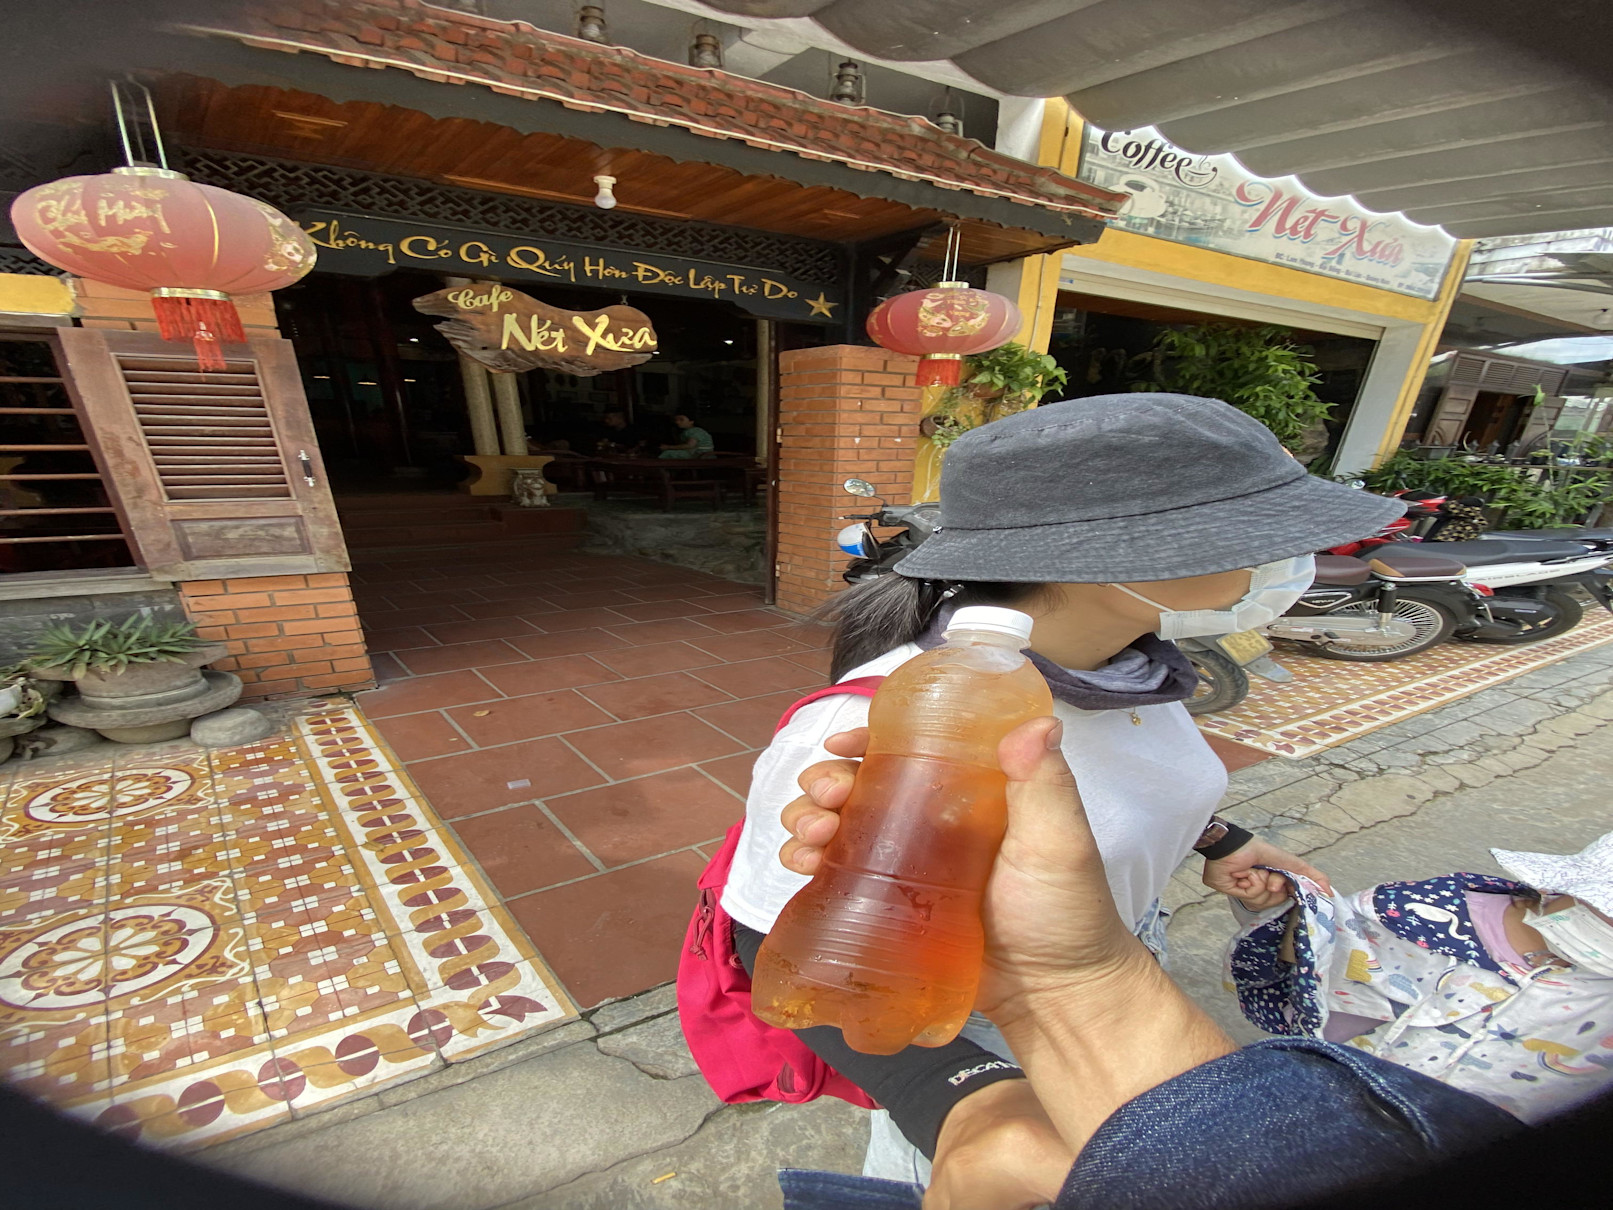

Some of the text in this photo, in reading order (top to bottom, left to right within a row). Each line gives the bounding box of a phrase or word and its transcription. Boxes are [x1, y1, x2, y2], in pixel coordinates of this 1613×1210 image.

[1101, 131, 1218, 187] Coffee
[294, 219, 397, 264] Không
[400, 235, 452, 259] Có
[459, 241, 500, 267] Gì
[506, 245, 576, 282] Quý
[632, 261, 684, 286] Độc
[688, 268, 728, 298] Lập
[727, 274, 759, 295] Tự
[761, 278, 798, 299] Do
[447, 284, 514, 312] Cafe
[501, 312, 658, 356] Nét Xưa
